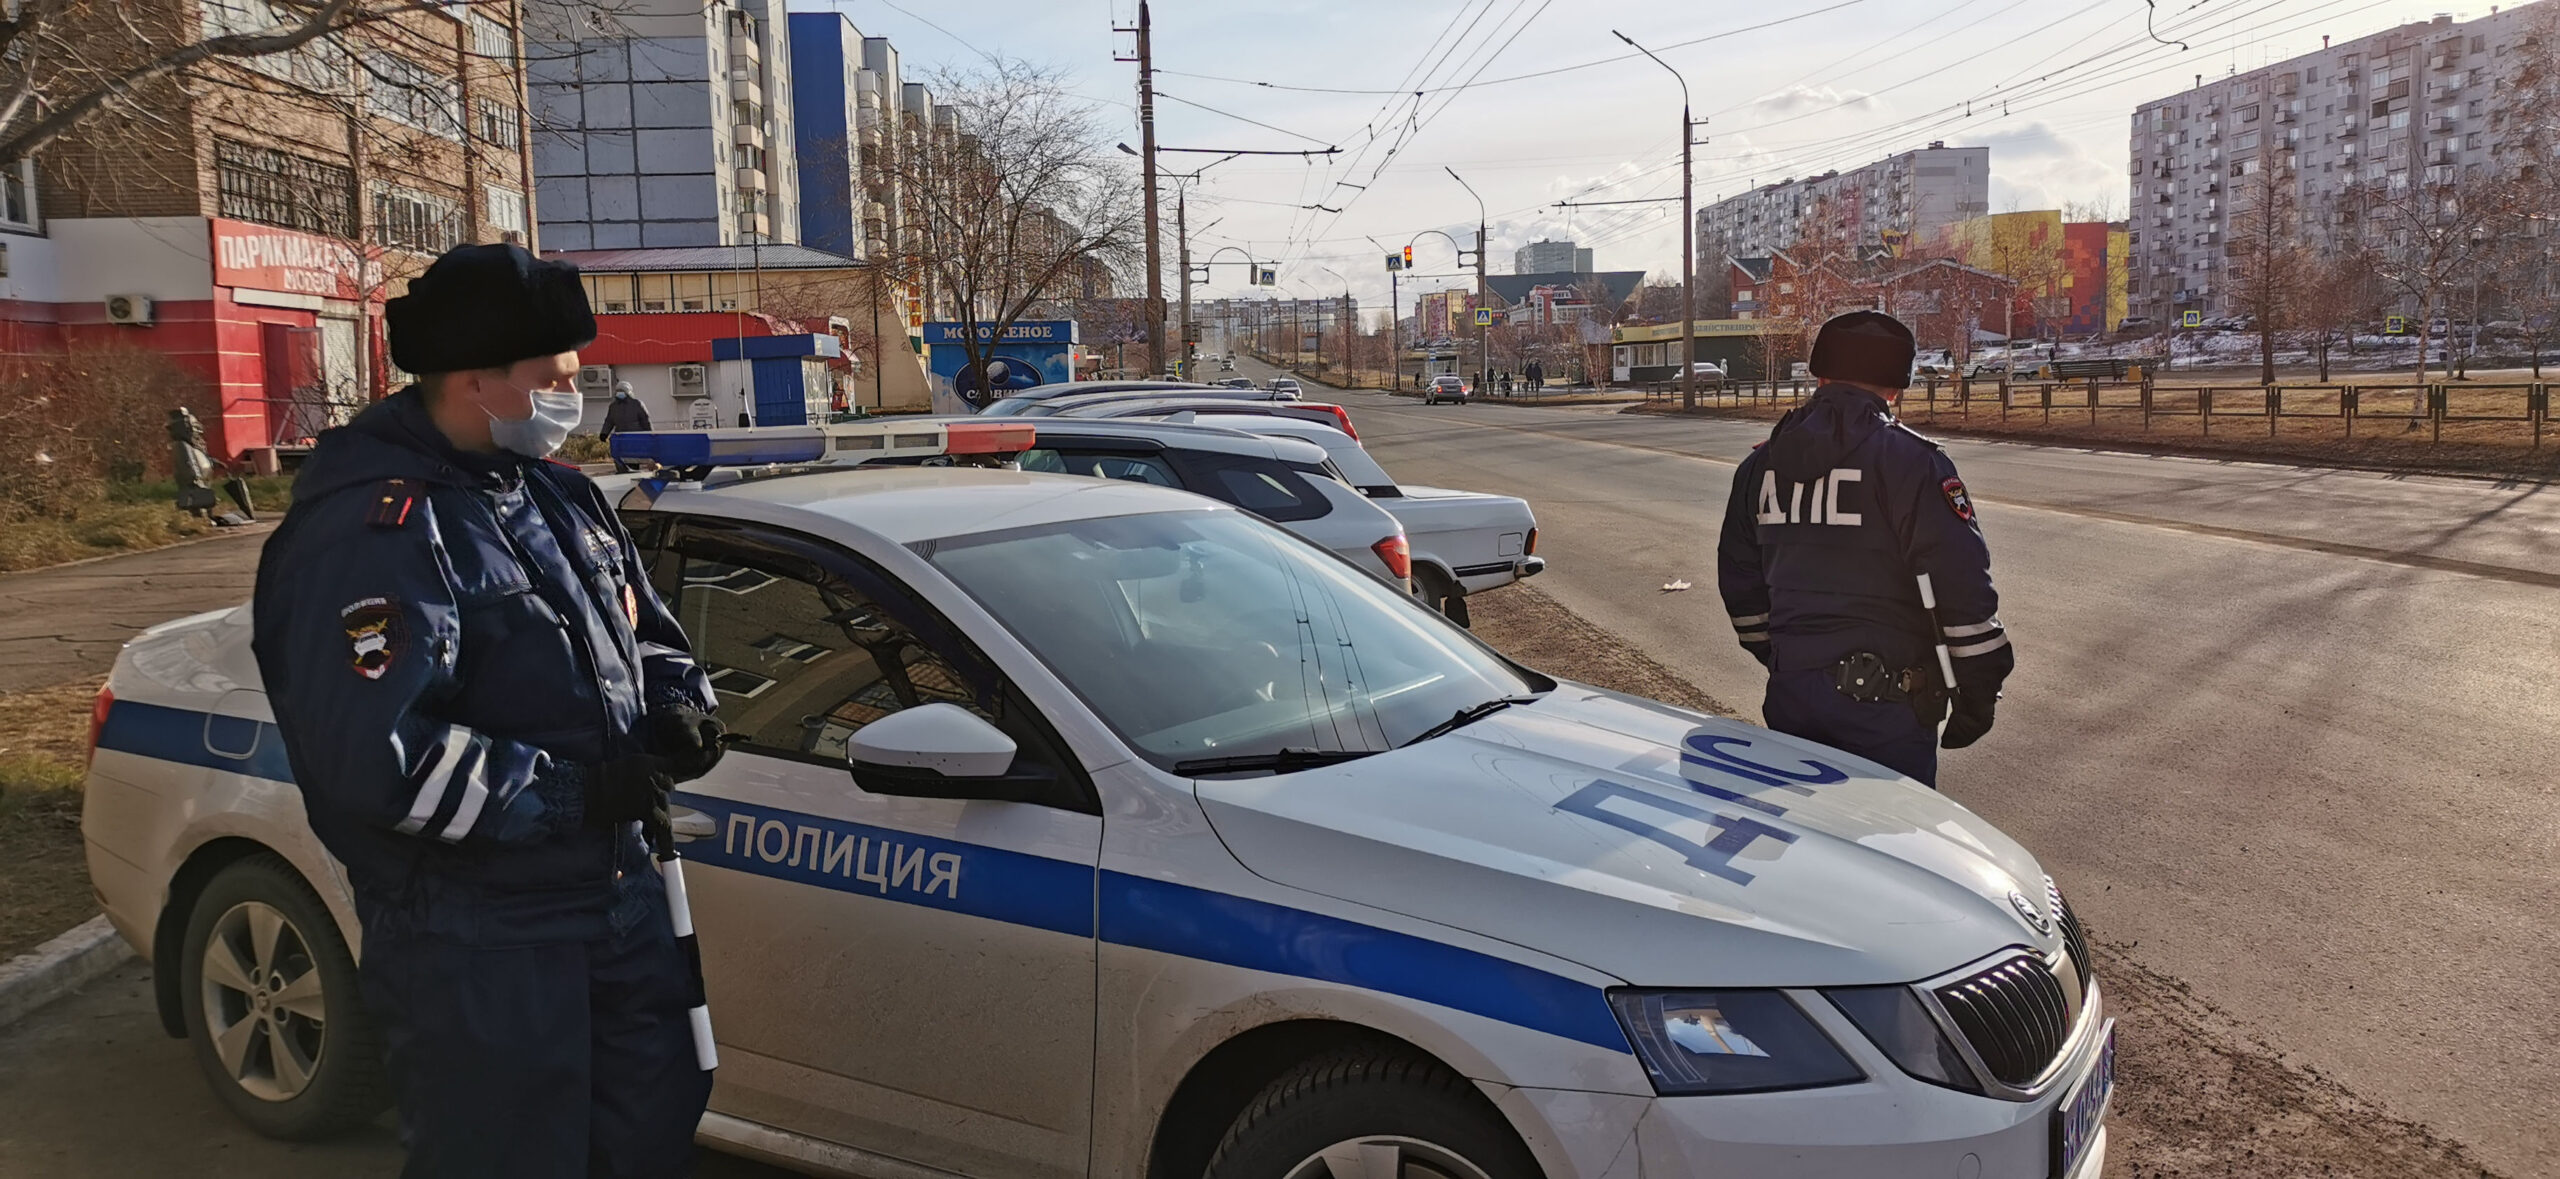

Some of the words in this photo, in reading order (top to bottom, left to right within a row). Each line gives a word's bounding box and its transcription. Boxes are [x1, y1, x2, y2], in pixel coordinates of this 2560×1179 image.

[1756, 468, 1862, 526] ДПС
[1552, 734, 1849, 887] ДПС
[725, 812, 962, 899] ПОЛИЦИЯ
